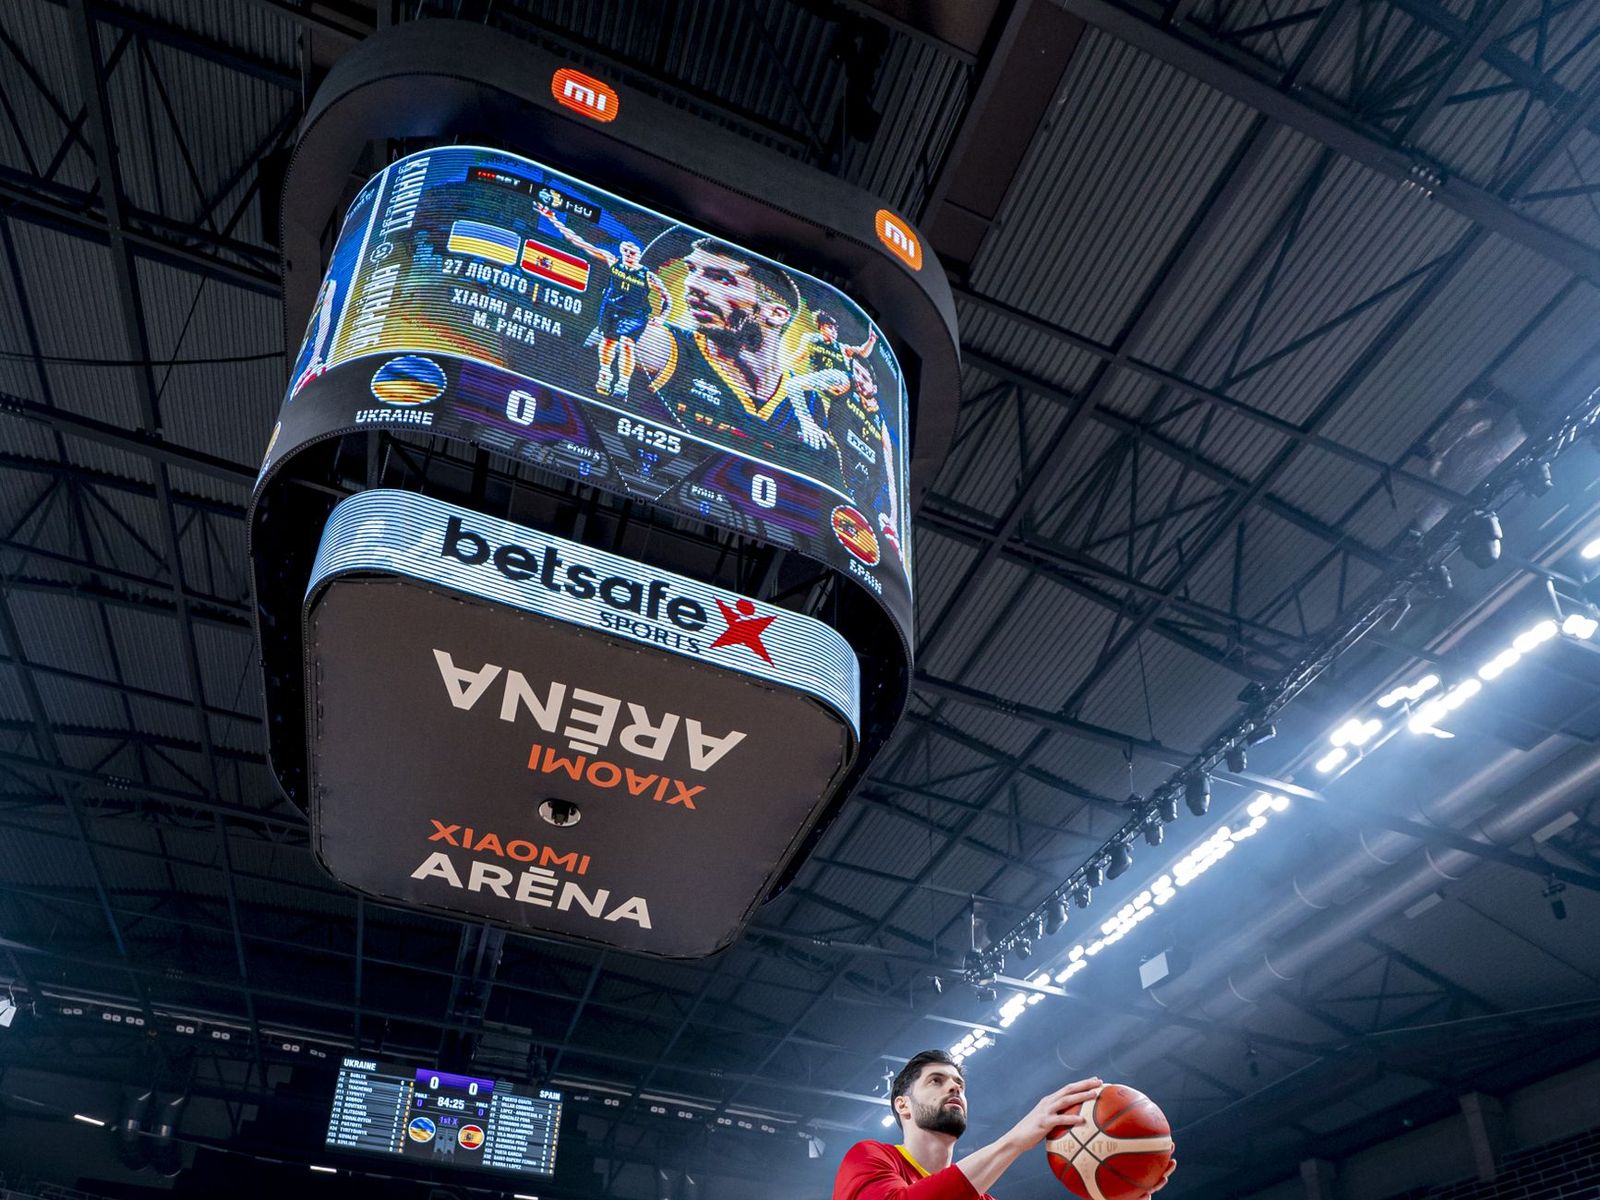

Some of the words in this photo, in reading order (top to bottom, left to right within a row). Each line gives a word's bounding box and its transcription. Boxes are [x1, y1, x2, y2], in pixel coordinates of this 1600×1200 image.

[442, 258, 464, 275] 27
[543, 287, 583, 314] 15:00
[451, 288, 508, 316] XIAOMI
[511, 306, 562, 337] ARENA
[355, 409, 434, 426] UKRAINE
[505, 389, 537, 426] 0
[751, 473, 777, 509] 0
[440, 516, 708, 634] betsafe
[599, 609, 703, 655] SPORTS
[432, 648, 748, 772] ARĒNA
[527, 743, 707, 810] XIAOMI
[428, 819, 591, 876] XIAOMI
[410, 852, 654, 930] ARĒNA
[343, 1058, 377, 1071] UKRAINE
[430, 1076, 439, 1089] 0
[437, 1096, 465, 1110] 84:25
[469, 1083, 479, 1095] 0
[539, 1089, 561, 1101] SPAIN
